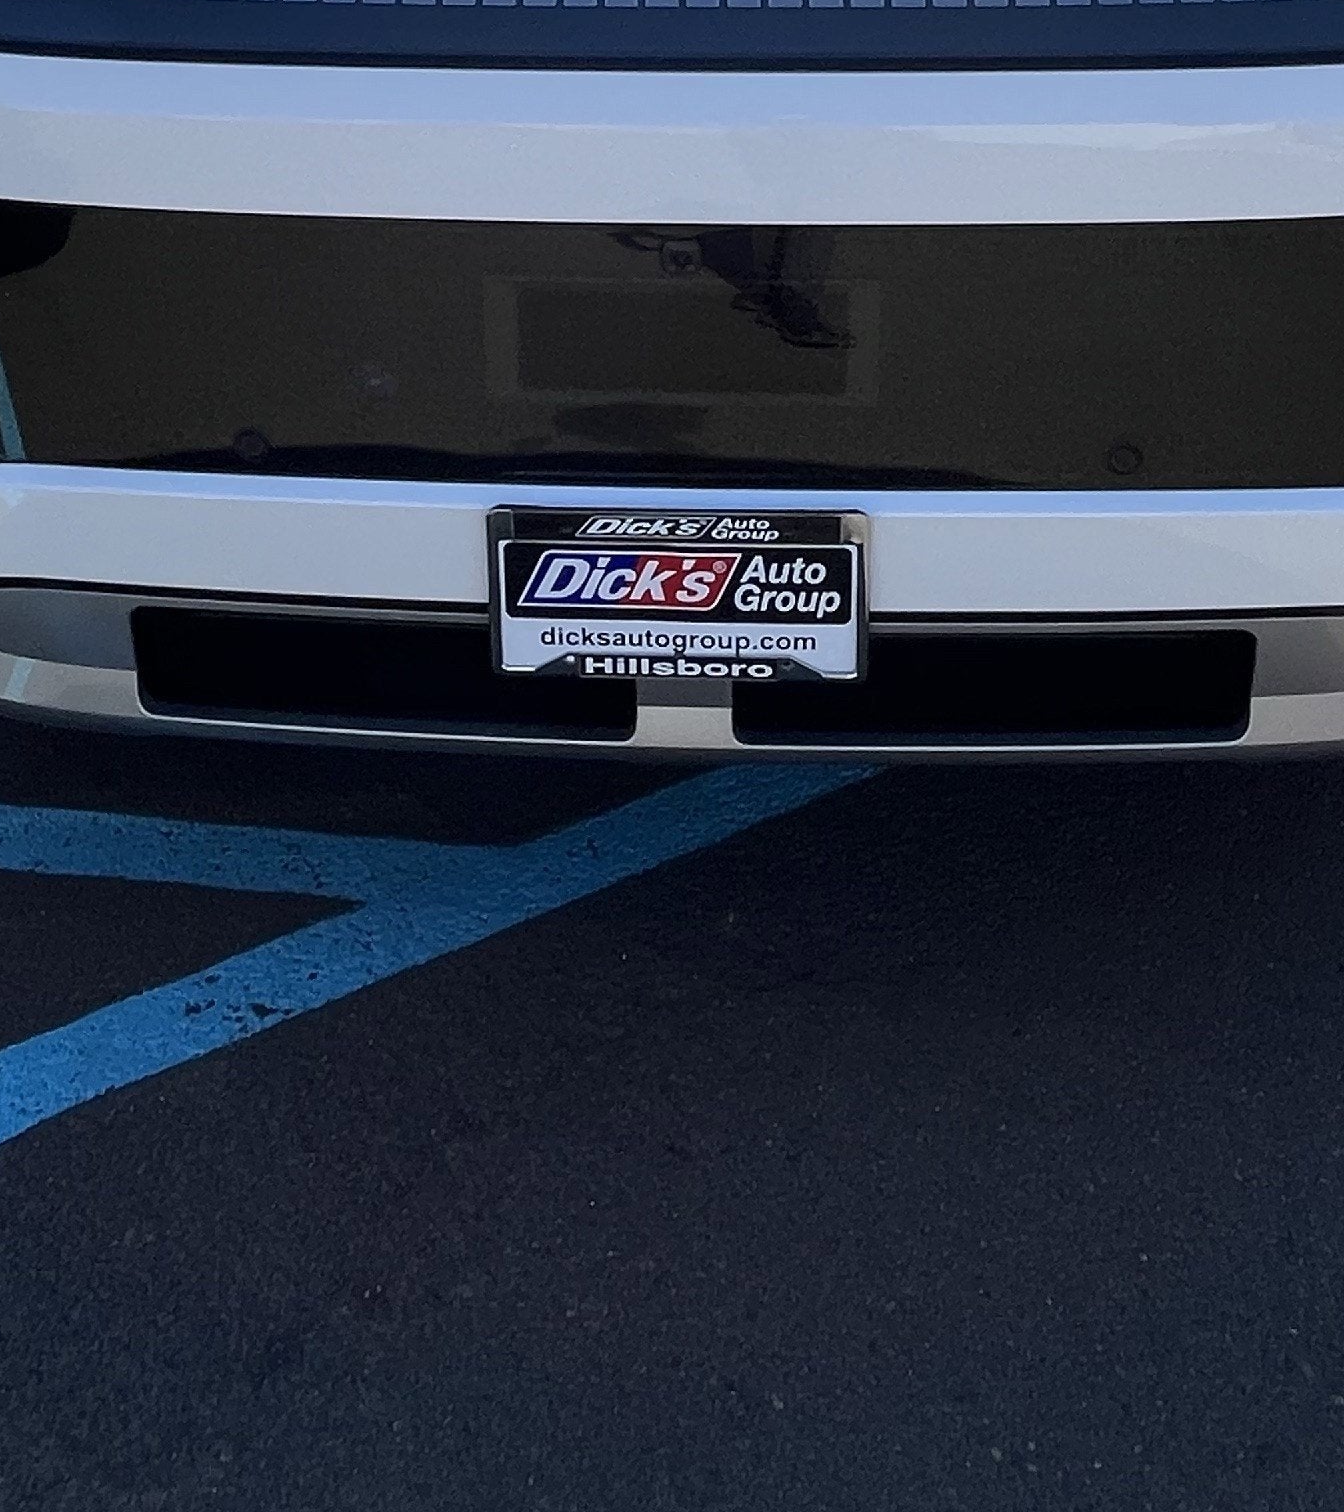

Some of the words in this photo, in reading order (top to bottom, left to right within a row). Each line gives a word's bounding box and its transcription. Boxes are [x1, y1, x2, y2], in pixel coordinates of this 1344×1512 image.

[586, 518, 704, 536] Dick's
[715, 517, 770, 530] Auto
[711, 528, 779, 542] Group
[534, 557, 716, 603] Dick's
[740, 555, 827, 585] Auto
[734, 584, 841, 619] Group
[540, 626, 817, 653] dicksautogroup.com
[584, 656, 773, 678] Hillsboro
